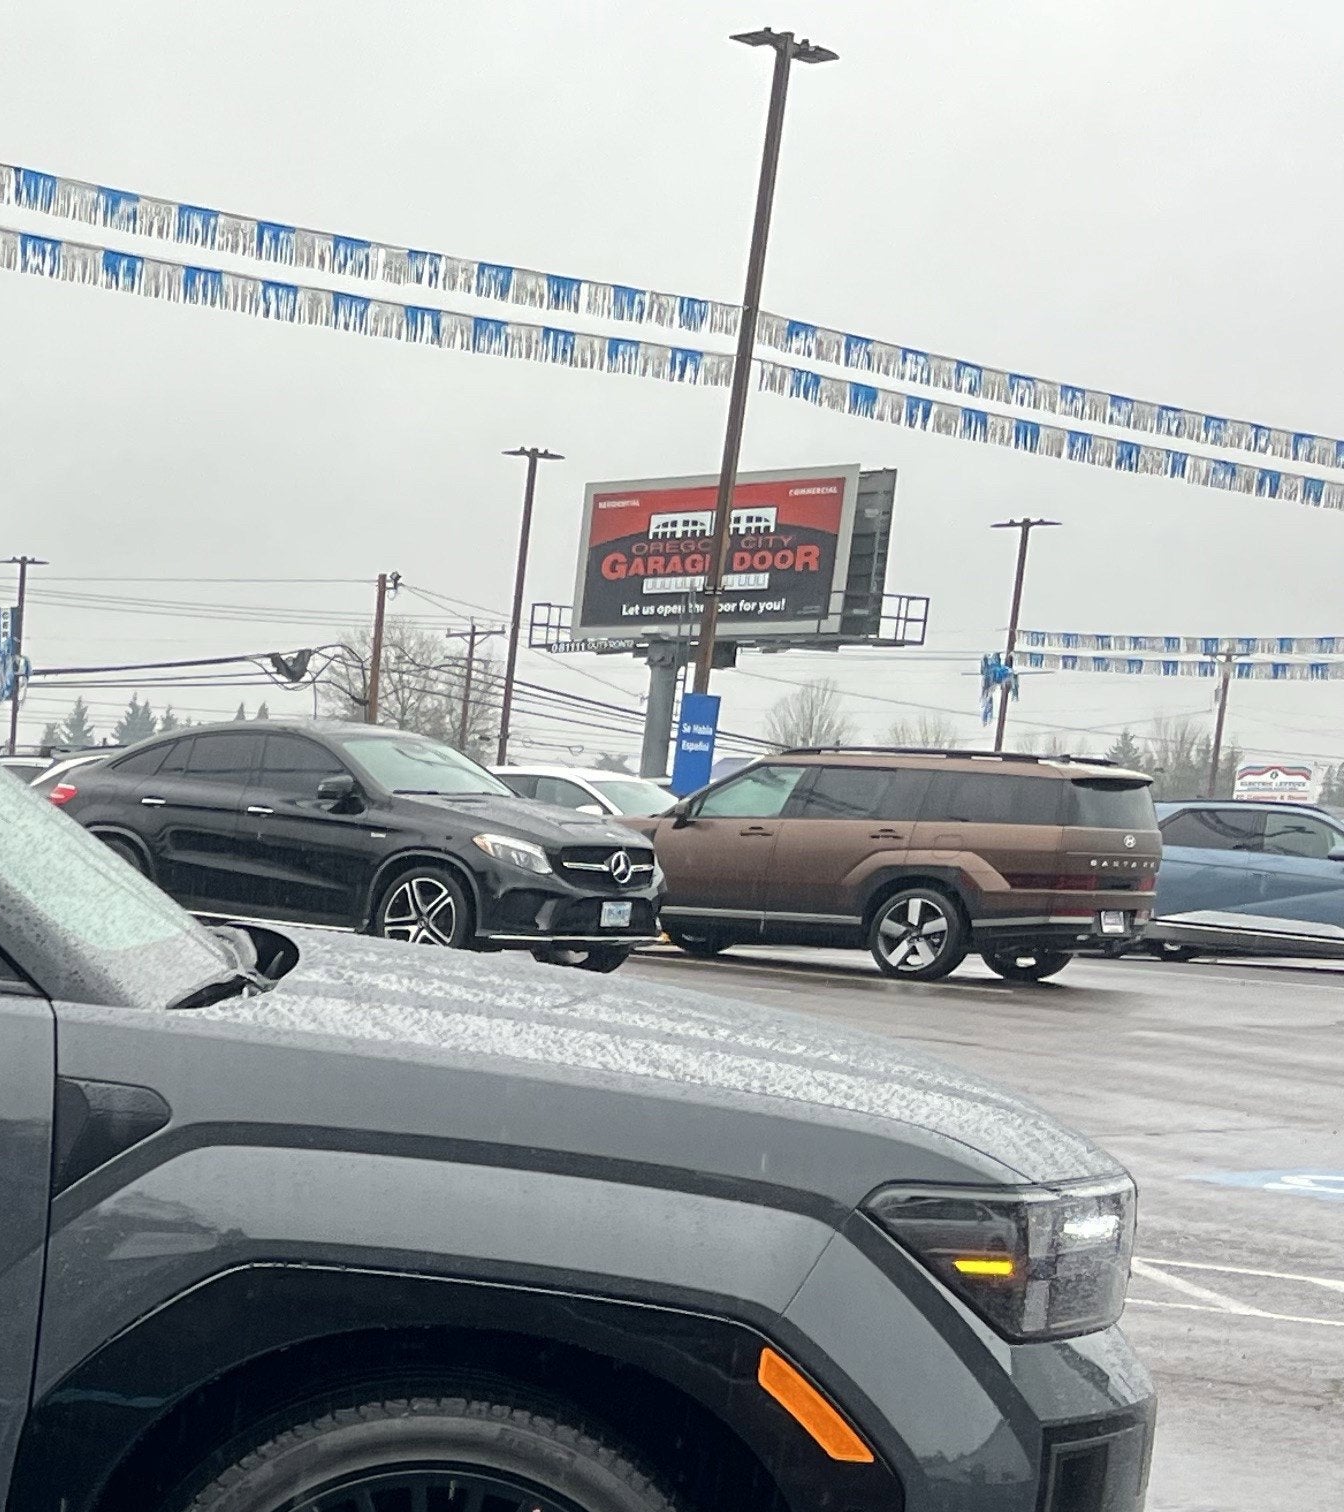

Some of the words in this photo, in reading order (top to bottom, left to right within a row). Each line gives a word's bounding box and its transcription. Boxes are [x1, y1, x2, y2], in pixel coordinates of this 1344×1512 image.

[631, 538, 713, 556] OREGO
[740, 533, 792, 549] CITY
[732, 544, 820, 572] DOOR
[621, 604, 640, 616] Let
[641, 604, 655, 615] us
[738, 599, 757, 612] for
[758, 597, 786, 615] you!
